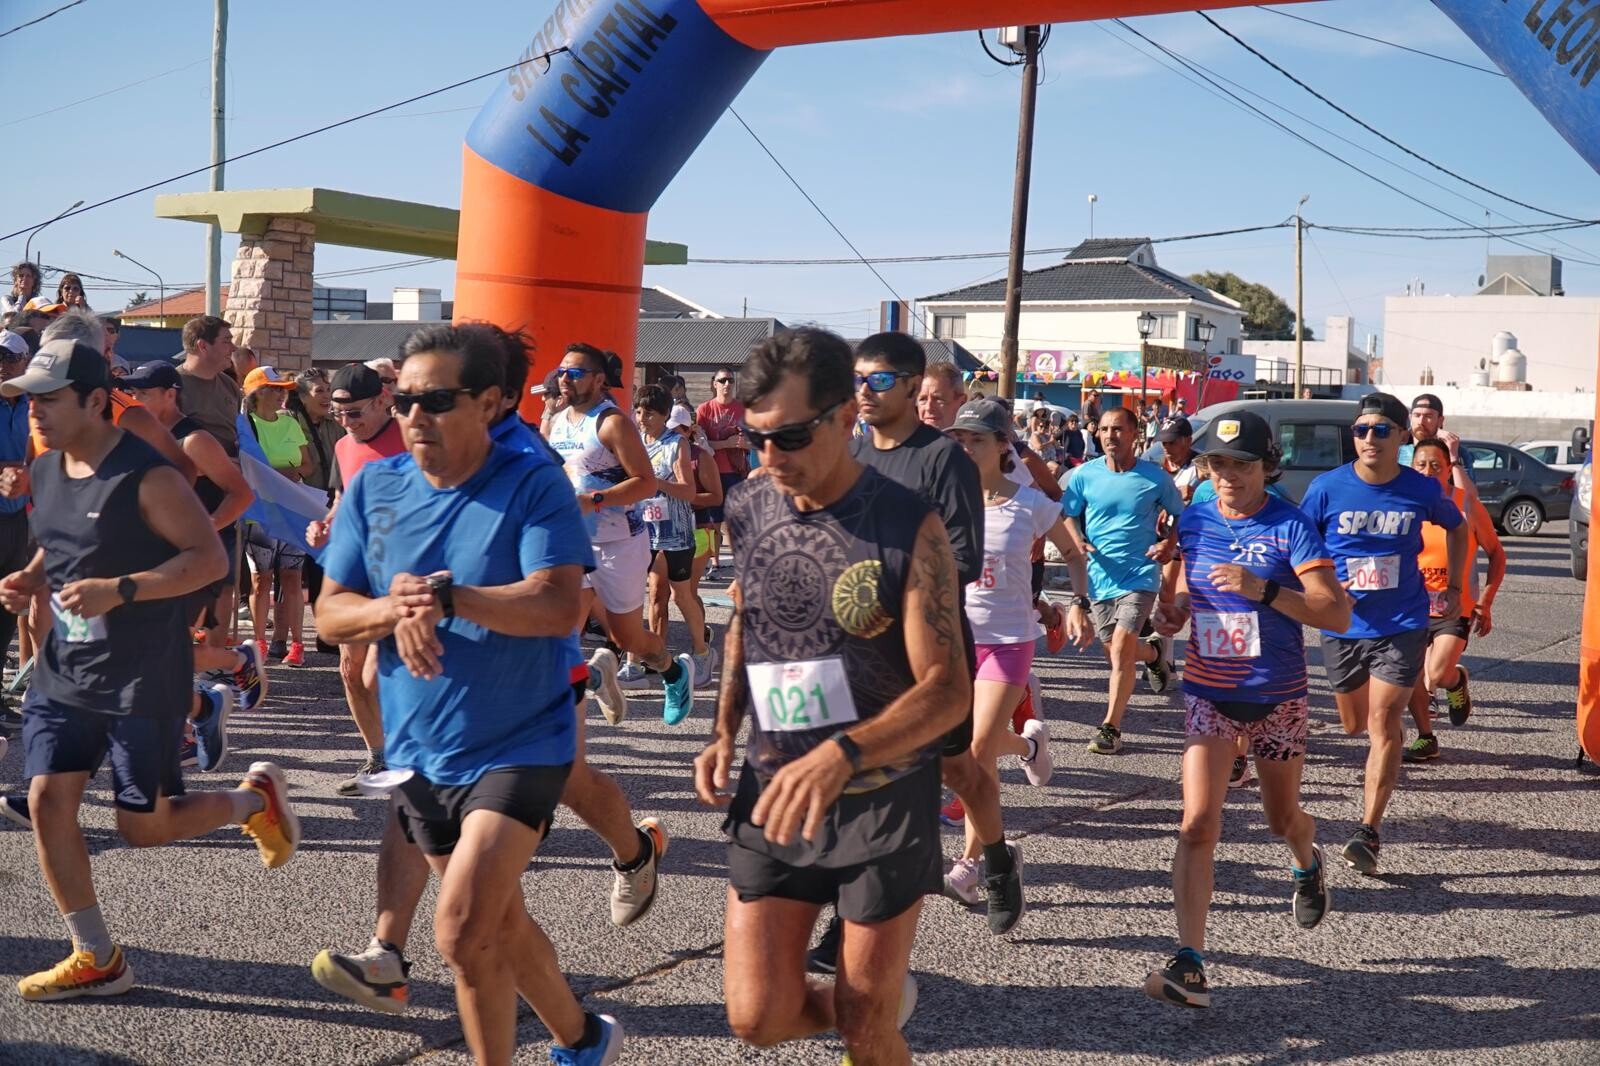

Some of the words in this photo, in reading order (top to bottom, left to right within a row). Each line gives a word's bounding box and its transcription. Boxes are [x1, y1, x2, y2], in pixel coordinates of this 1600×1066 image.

[526, 105, 591, 166] LA
[560, 0, 678, 118] CAPITAL
[1337, 510, 1416, 535] SPORT
[1357, 568, 1389, 588] 046
[1204, 628, 1247, 656] 126
[768, 682, 830, 724] 021
